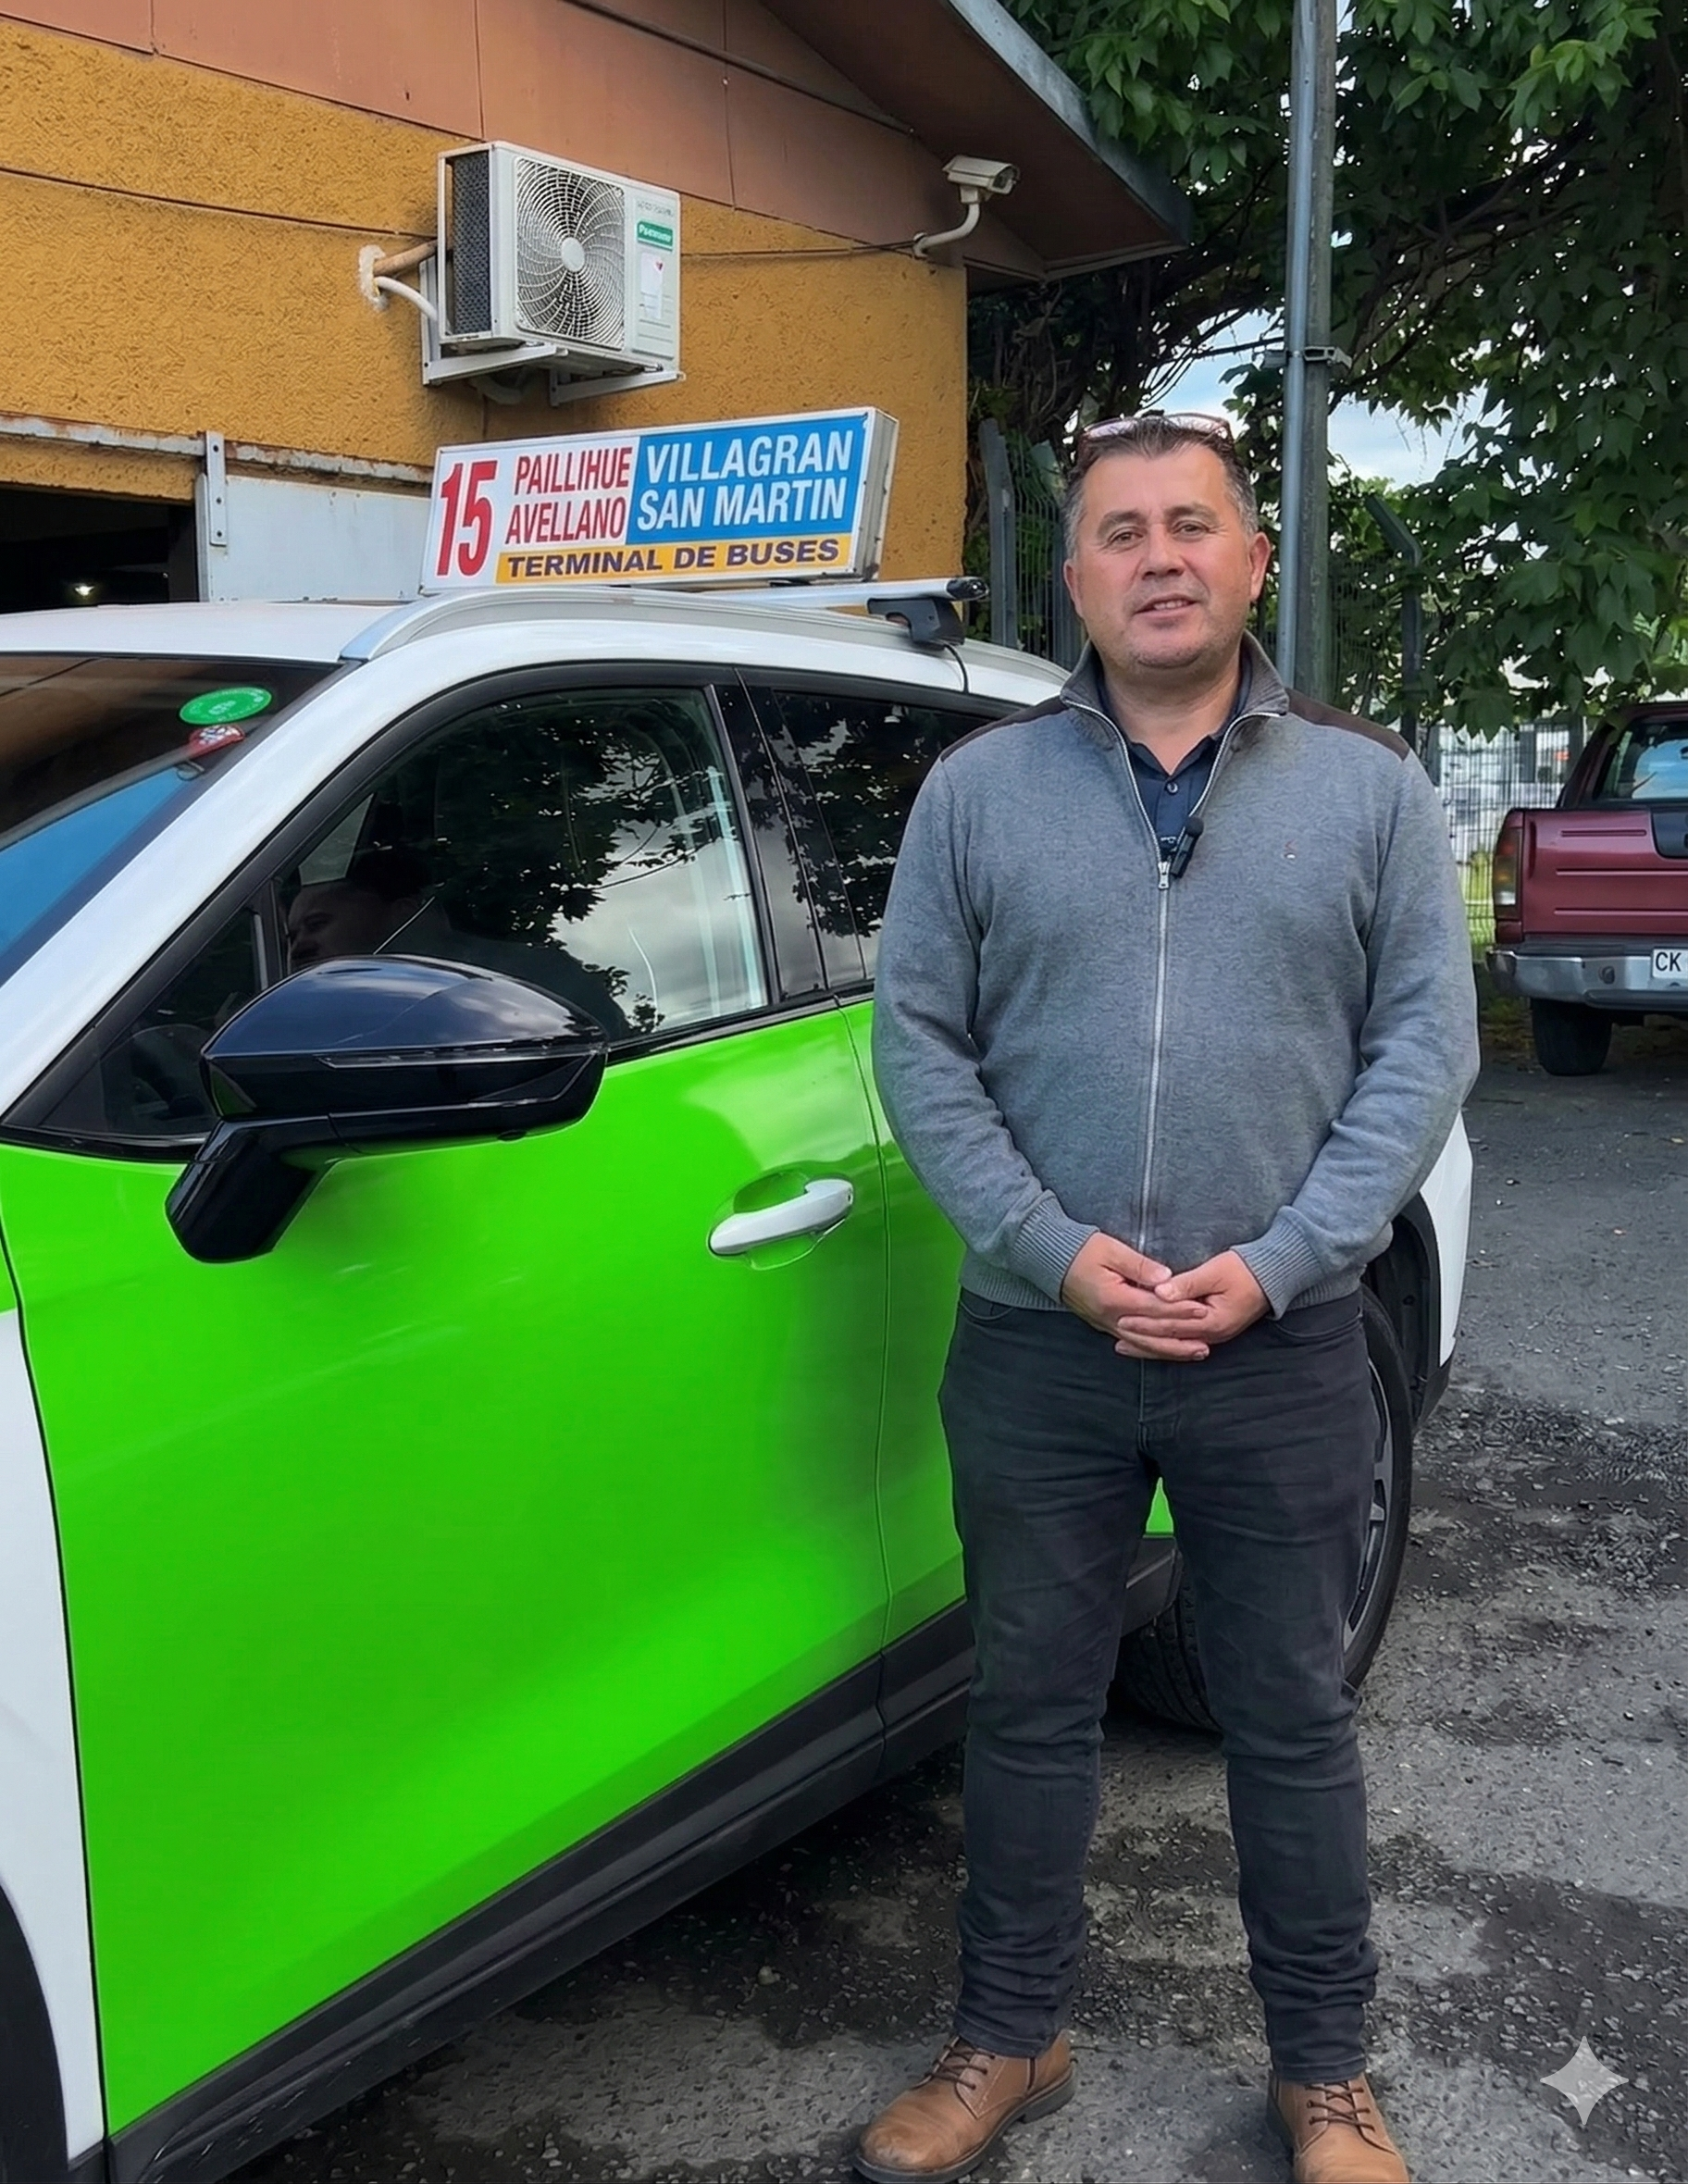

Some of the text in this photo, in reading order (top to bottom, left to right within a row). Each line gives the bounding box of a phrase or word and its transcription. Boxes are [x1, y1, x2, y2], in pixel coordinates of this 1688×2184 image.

[515, 446, 633, 495] PAILLIHUE
[646, 429, 853, 483] VILLAGRAN
[437, 460, 498, 577] 15
[504, 497, 627, 545] AVELLANO
[637, 477, 848, 531] SAN MARTIN
[508, 539, 839, 577] TERMINAL DE BUSES
[1655, 950, 1682, 972] CK
